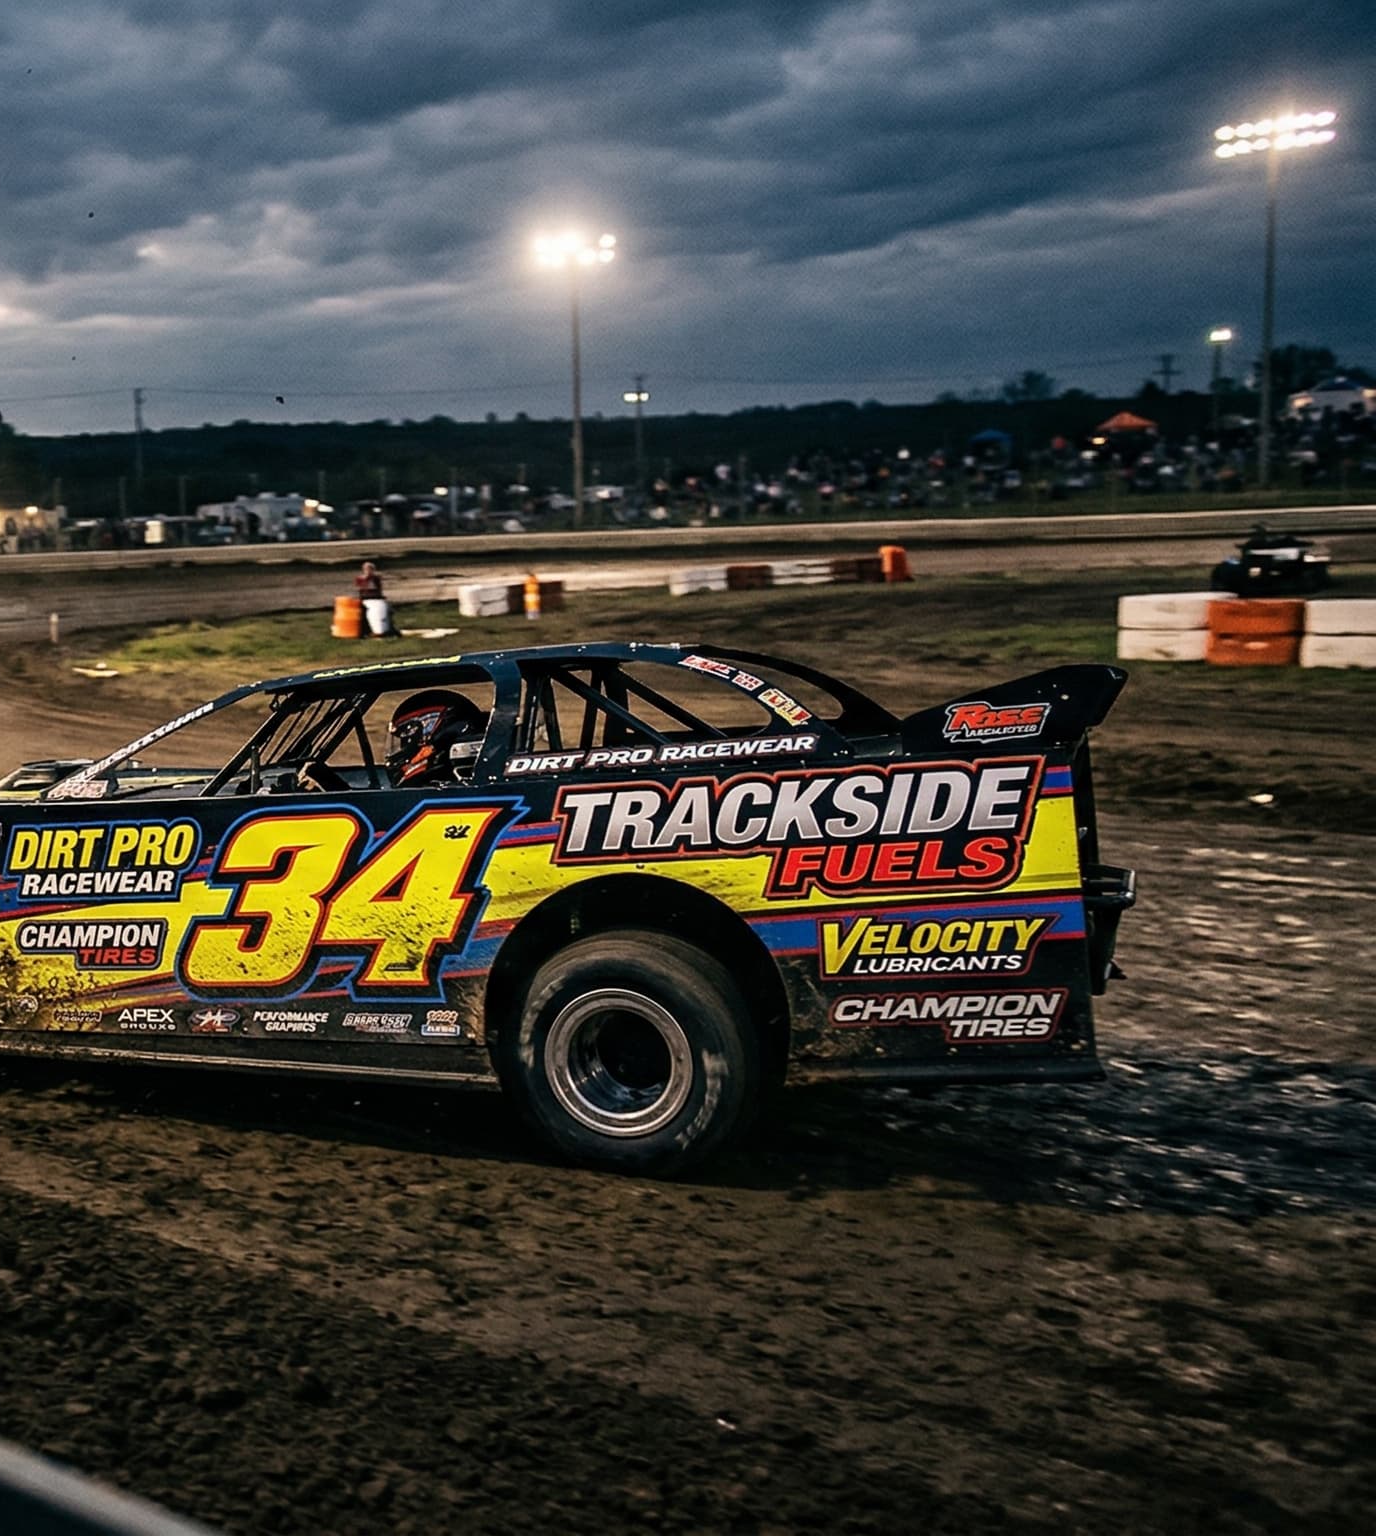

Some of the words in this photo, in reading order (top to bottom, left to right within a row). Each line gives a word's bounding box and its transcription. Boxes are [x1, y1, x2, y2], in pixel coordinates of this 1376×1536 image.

[507, 754, 584, 774] DIRT
[587, 749, 650, 767] PRO
[661, 736, 816, 762] RACEWEAR
[563, 766, 1030, 853] TRACKSIDE
[9, 828, 105, 871] DIRT
[107, 823, 195, 870] PRO
[779, 837, 1009, 886] FUELS
[20, 869, 175, 896] RACEWEAR
[184, 807, 503, 988] 34
[19, 923, 161, 949] CHAMPION
[822, 917, 1046, 974] VELOCITY
[78, 948, 157, 966] TIRES
[853, 954, 1023, 974] LUBRICANTS
[118, 1008, 175, 1023] APEX
[834, 993, 1062, 1022] CHAMPION
[949, 1017, 1051, 1038] TIRES
